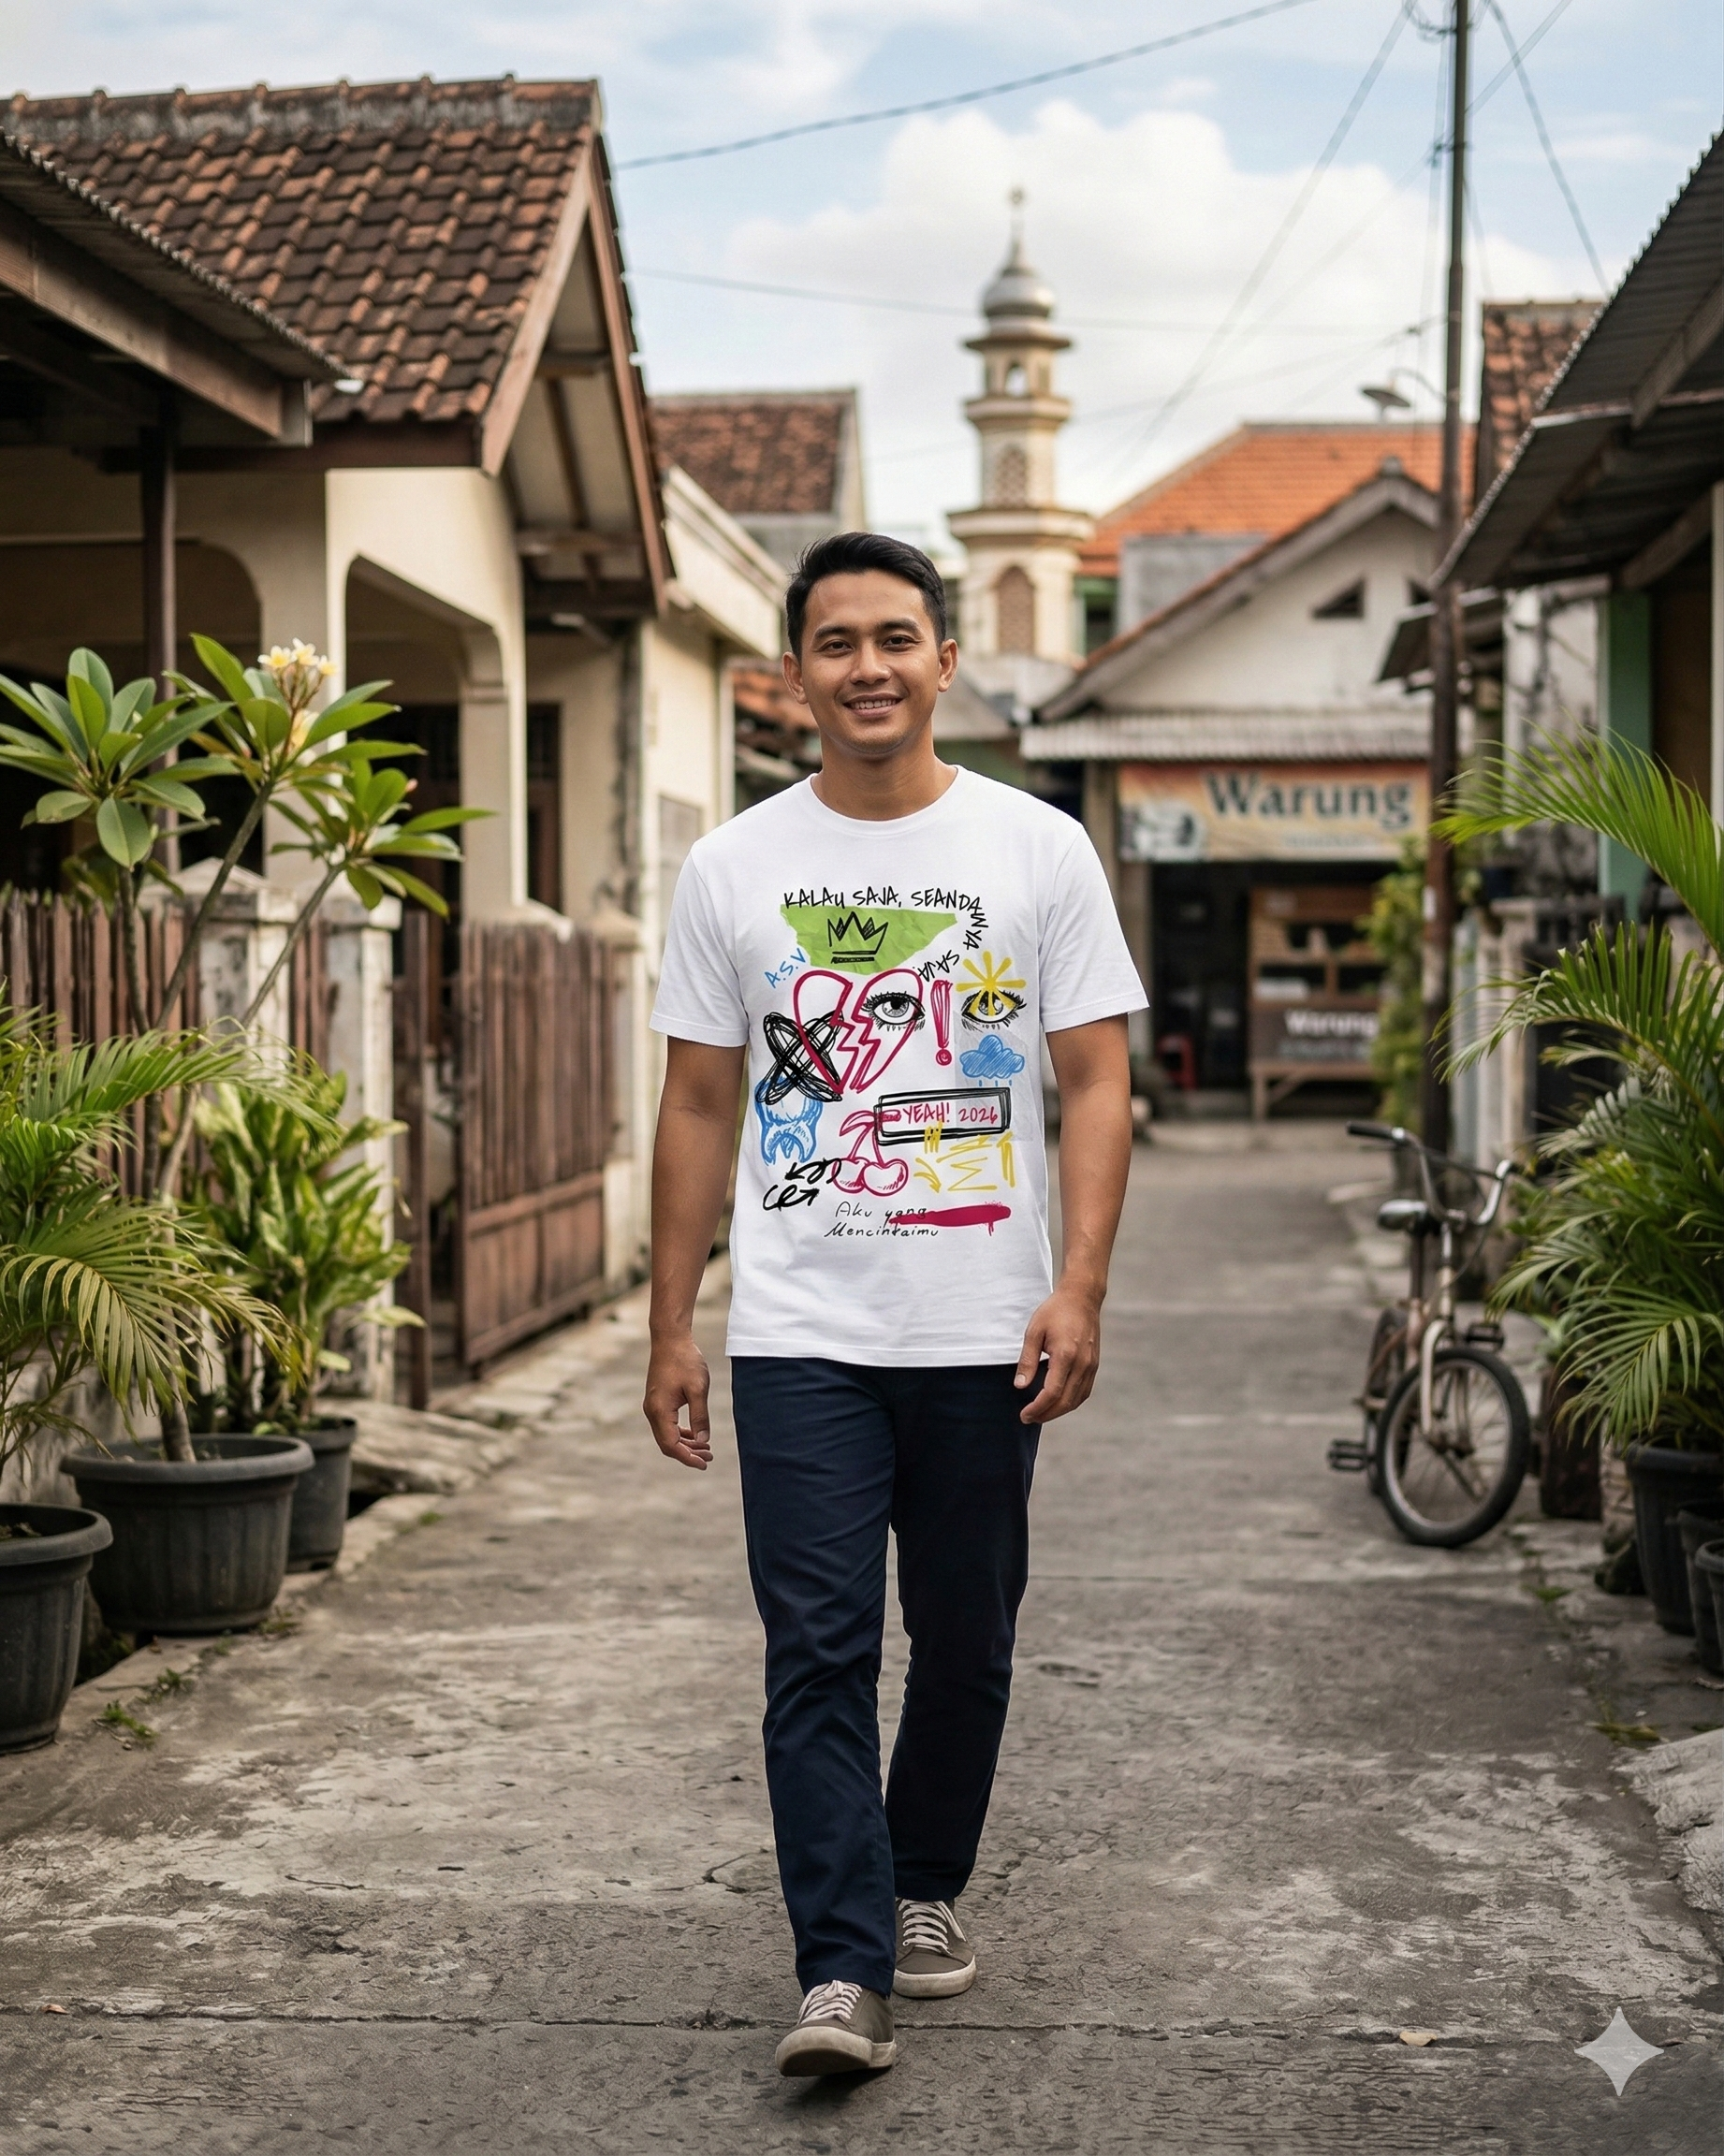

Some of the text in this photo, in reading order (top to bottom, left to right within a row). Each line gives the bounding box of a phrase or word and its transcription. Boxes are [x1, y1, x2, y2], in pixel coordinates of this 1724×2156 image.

[1203, 769, 1411, 830] Warung
[852, 885, 902, 908] SAJA,
[902, 1101, 999, 1124] YEAH! 2026
[835, 1201, 872, 1217] Aku
[824, 1221, 940, 1238] Mencintaimu
